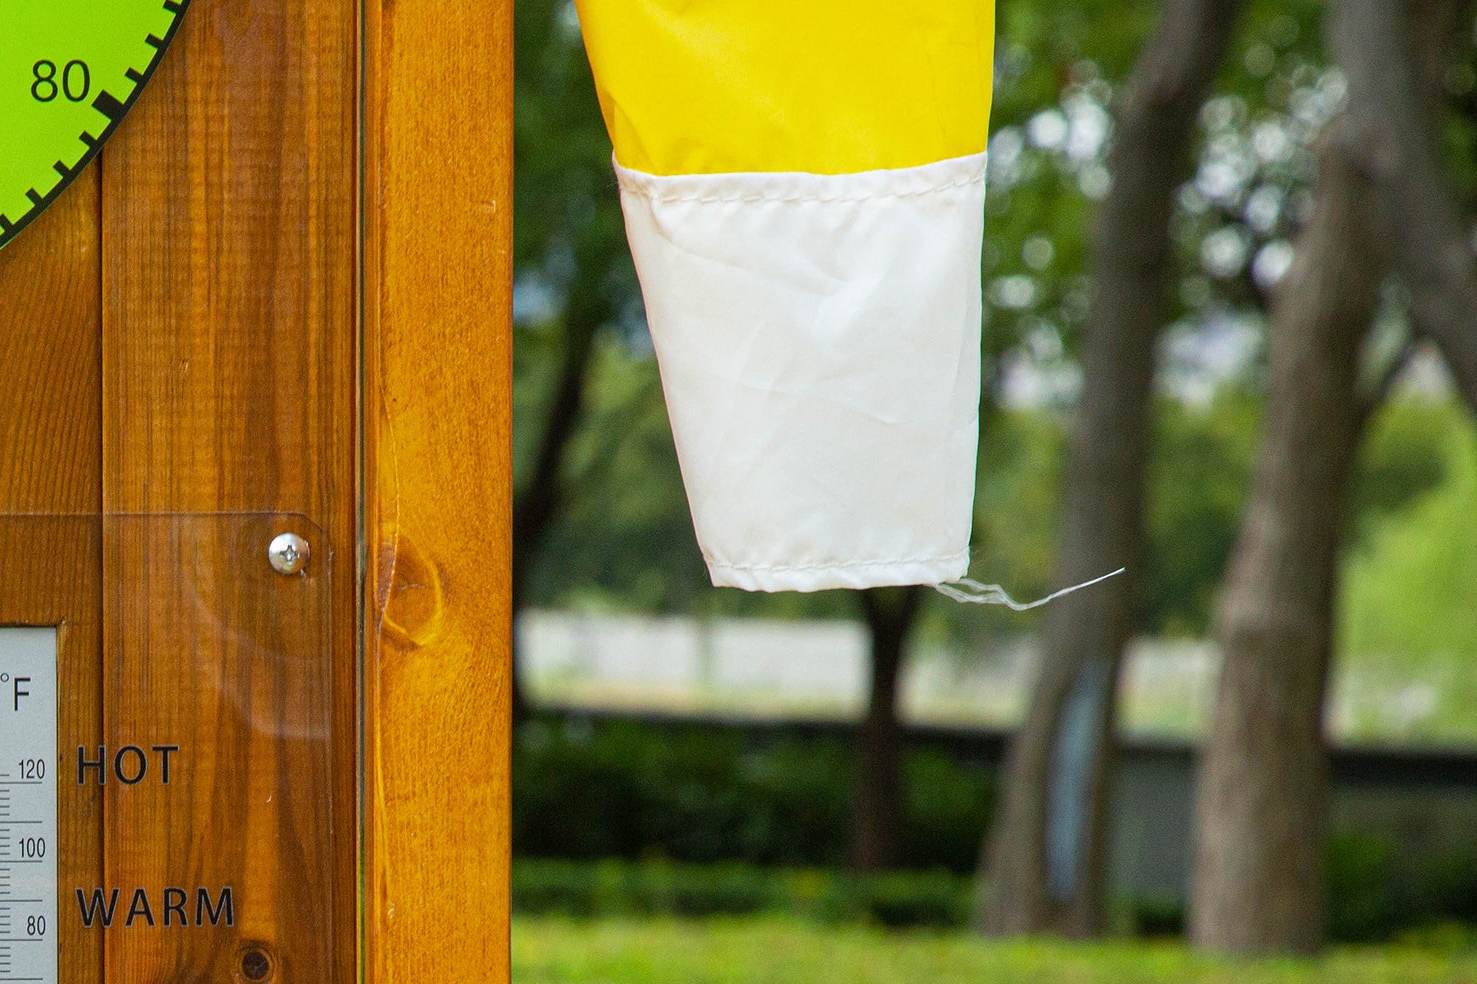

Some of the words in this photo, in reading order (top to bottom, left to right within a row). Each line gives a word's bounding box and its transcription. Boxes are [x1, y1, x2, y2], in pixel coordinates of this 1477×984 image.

[30, 59, 91, 102] 80
[18, 758, 46, 780] 120
[75, 744, 180, 786] HOT
[18, 837, 46, 859] 100
[75, 886, 235, 929] WARM
[26, 915, 47, 936] 80
